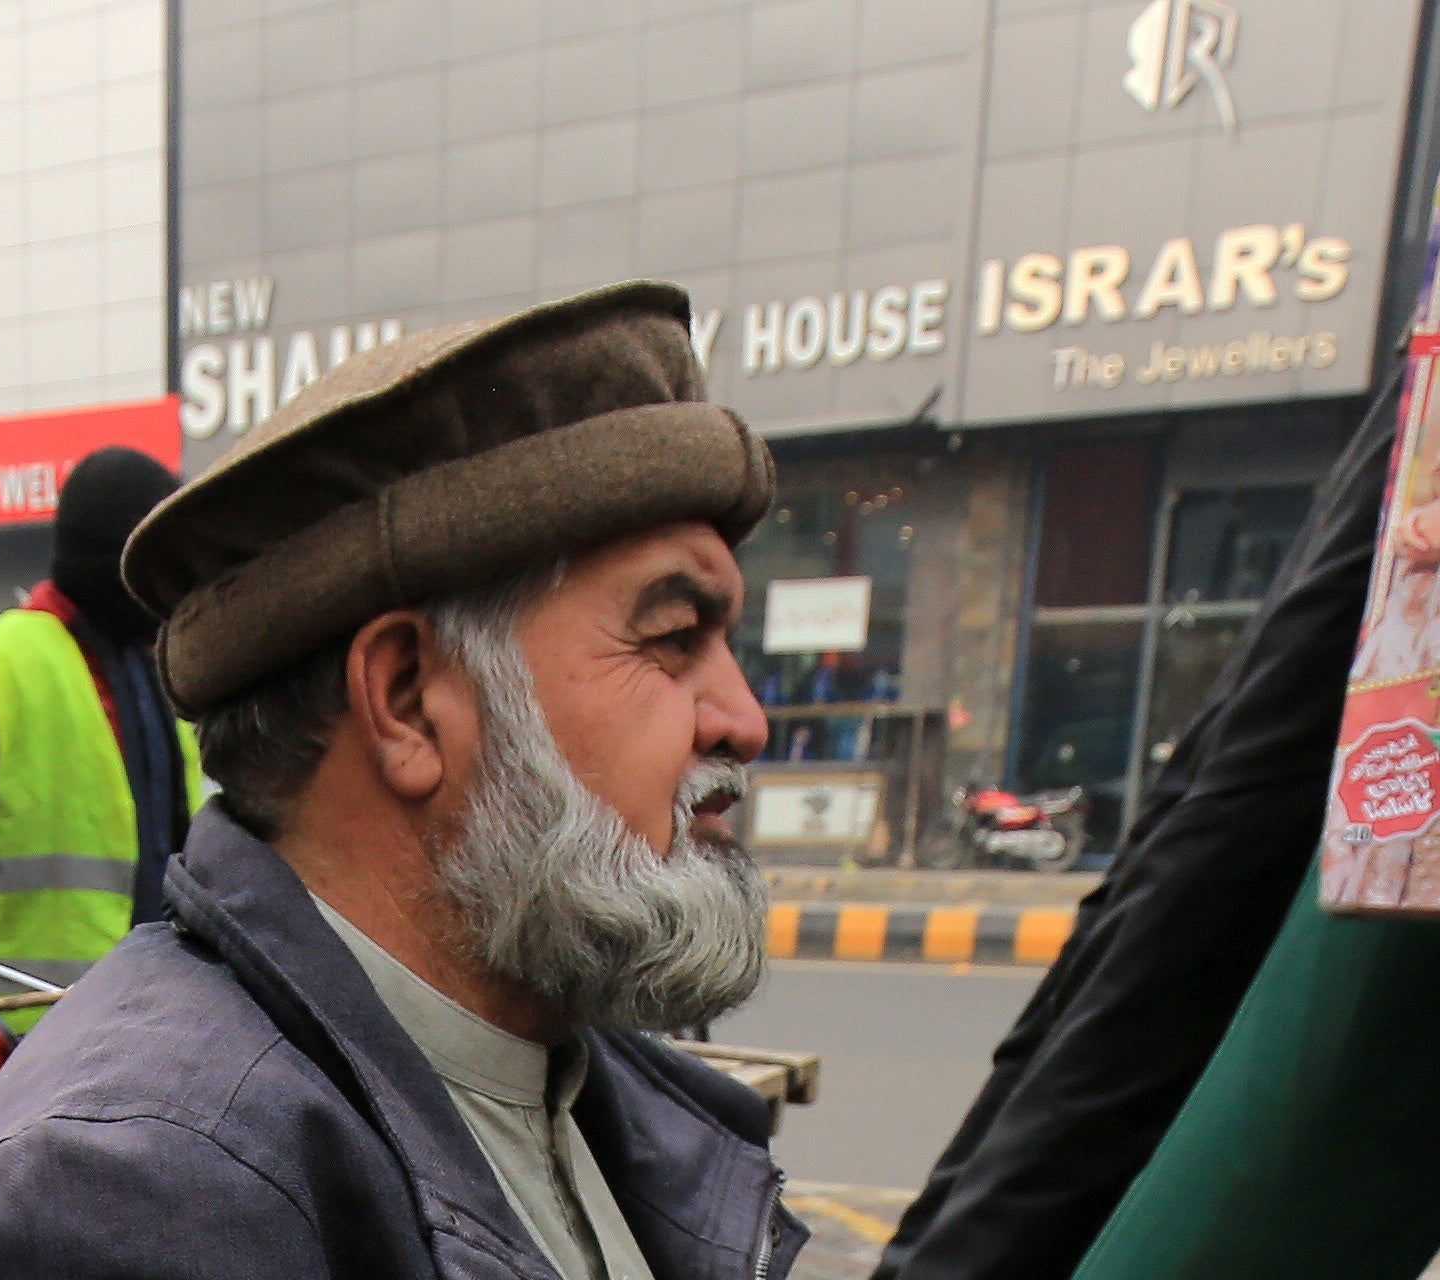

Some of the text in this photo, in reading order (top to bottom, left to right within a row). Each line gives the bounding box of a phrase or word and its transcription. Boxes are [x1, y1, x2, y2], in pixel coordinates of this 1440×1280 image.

[178, 277, 274, 338] NEW
[976, 222, 1352, 338] ISRAR's
[741, 280, 951, 377] HOUSE
[1050, 330, 1339, 390] The Jewellers
